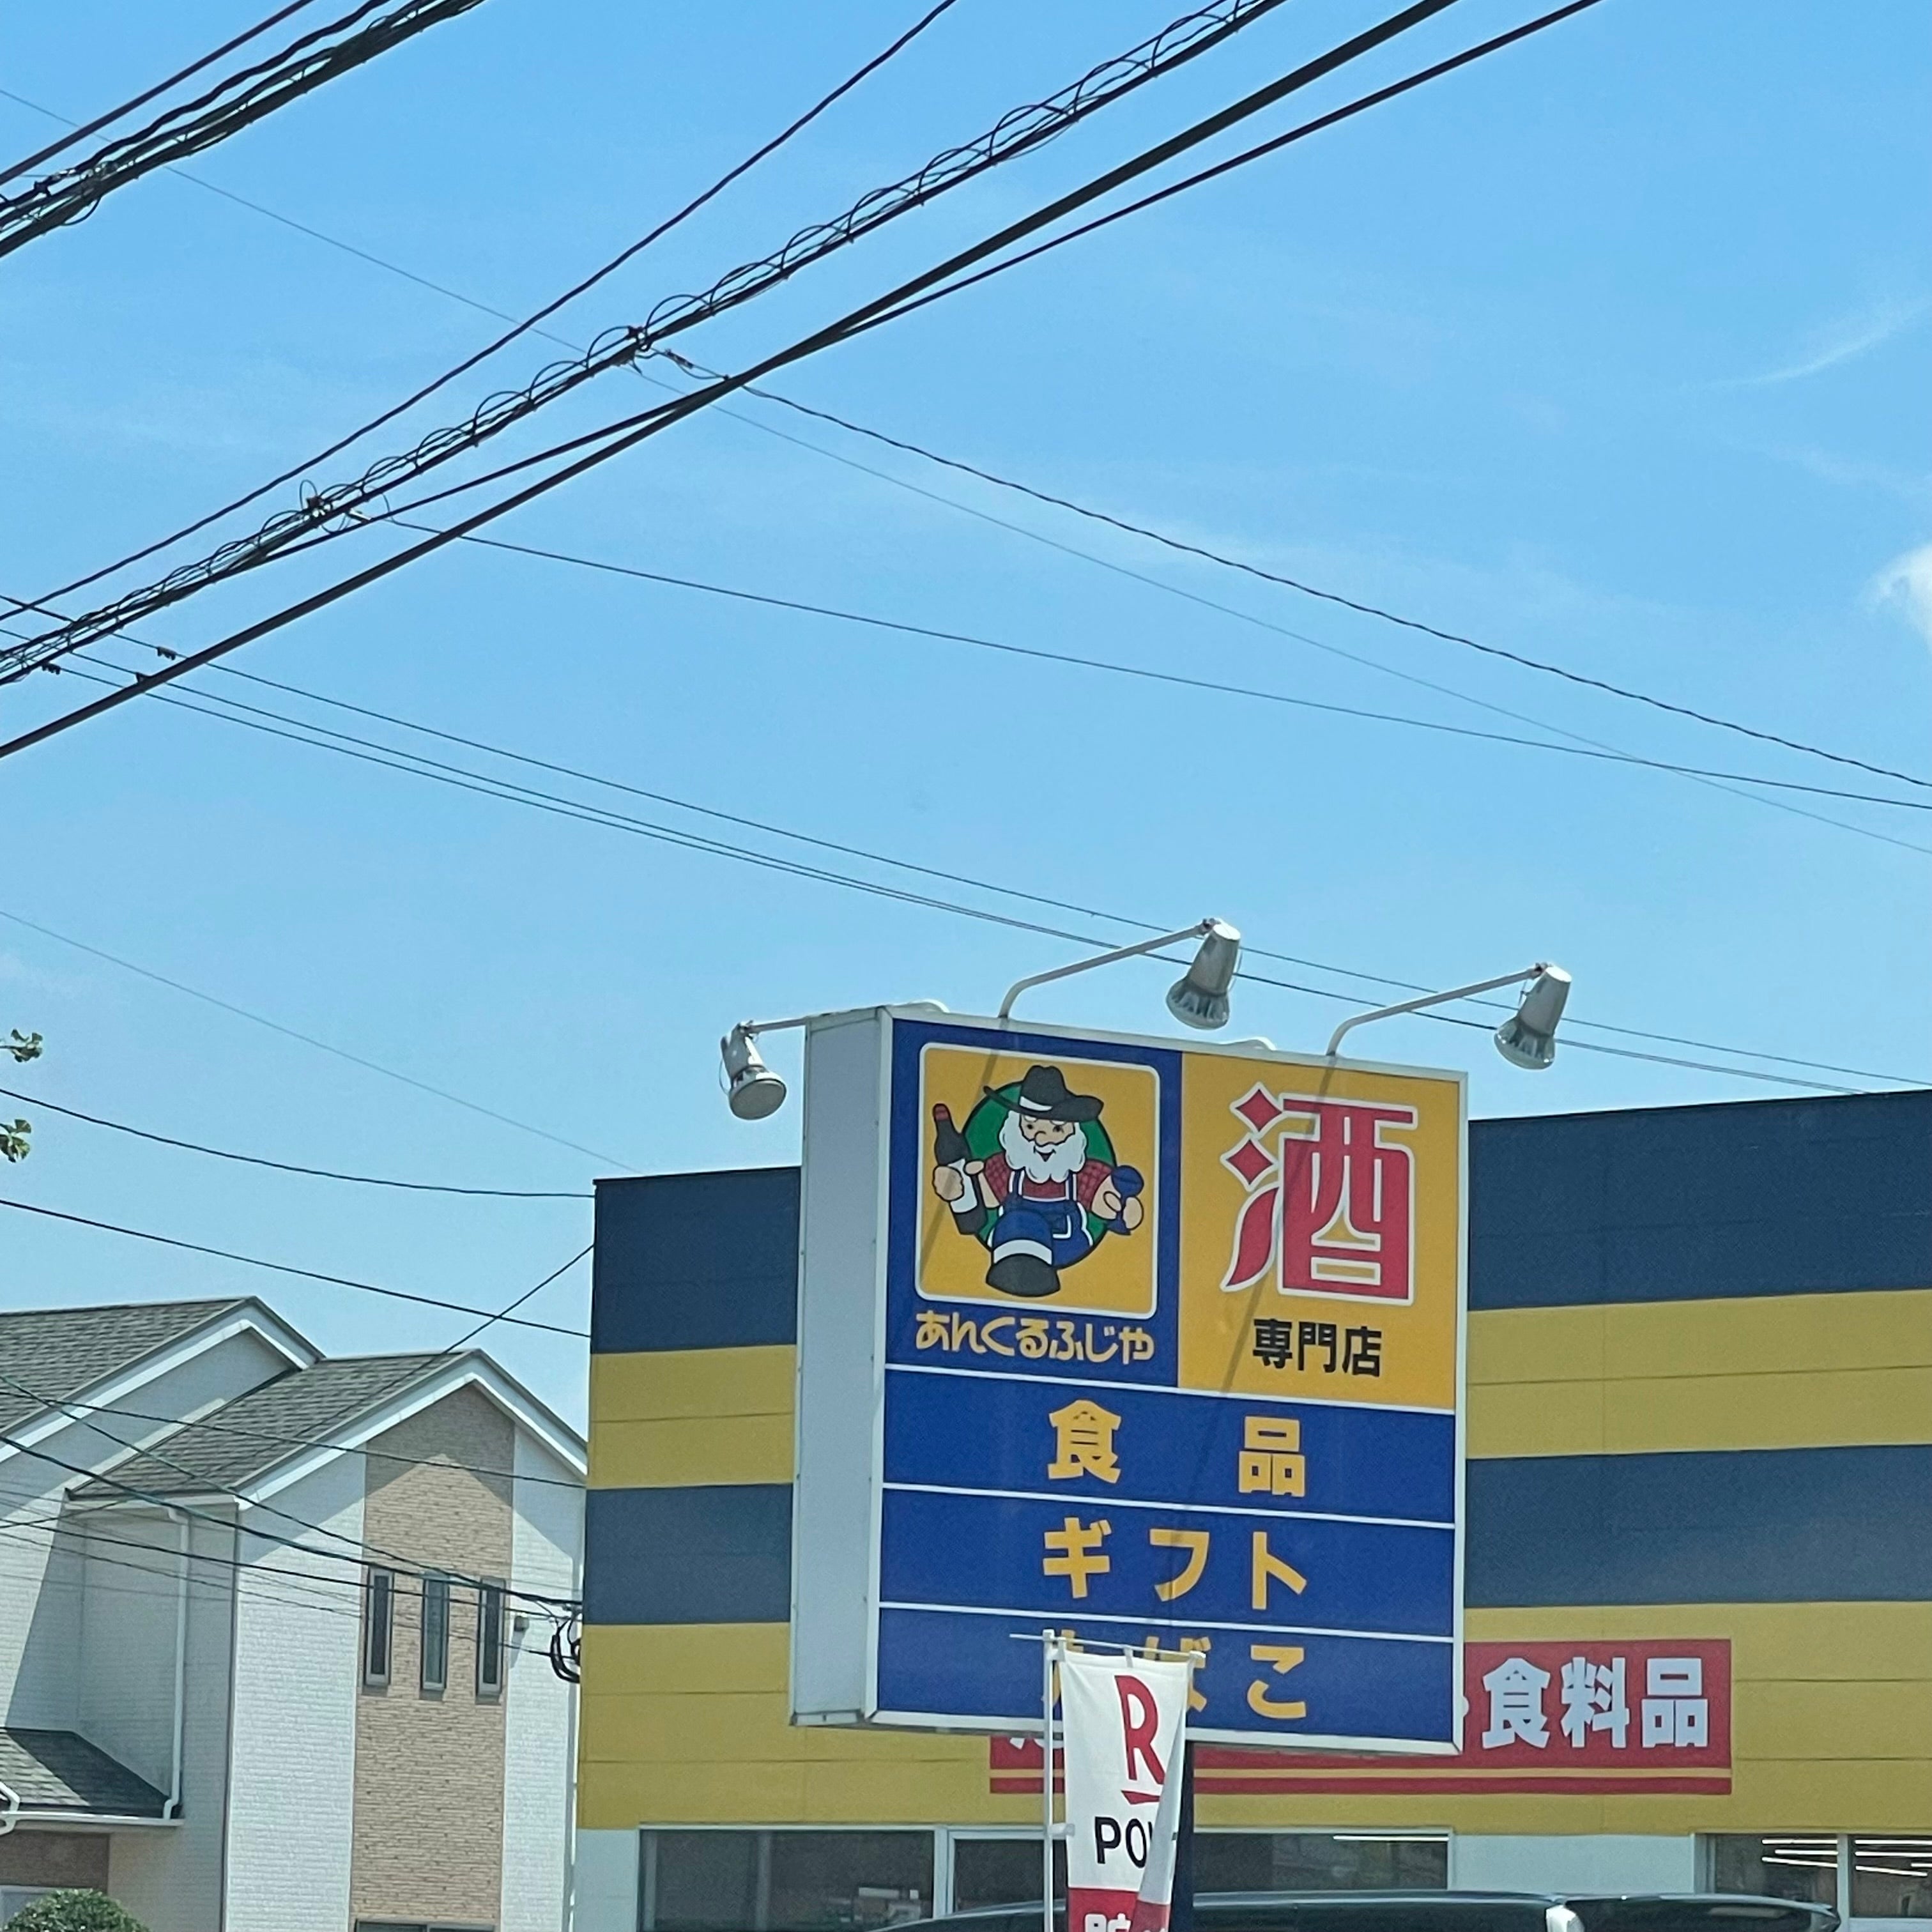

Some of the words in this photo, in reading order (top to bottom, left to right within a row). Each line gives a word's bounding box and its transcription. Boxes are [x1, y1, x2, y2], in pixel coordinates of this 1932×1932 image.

[1220, 1082, 1418, 1305] 酒
[916, 1310, 1154, 1365] あんくるふじや
[1253, 1319, 1382, 1377] 専門店
[1048, 1400, 1306, 1497] 食品
[1043, 1517, 1307, 1610] ギフト
